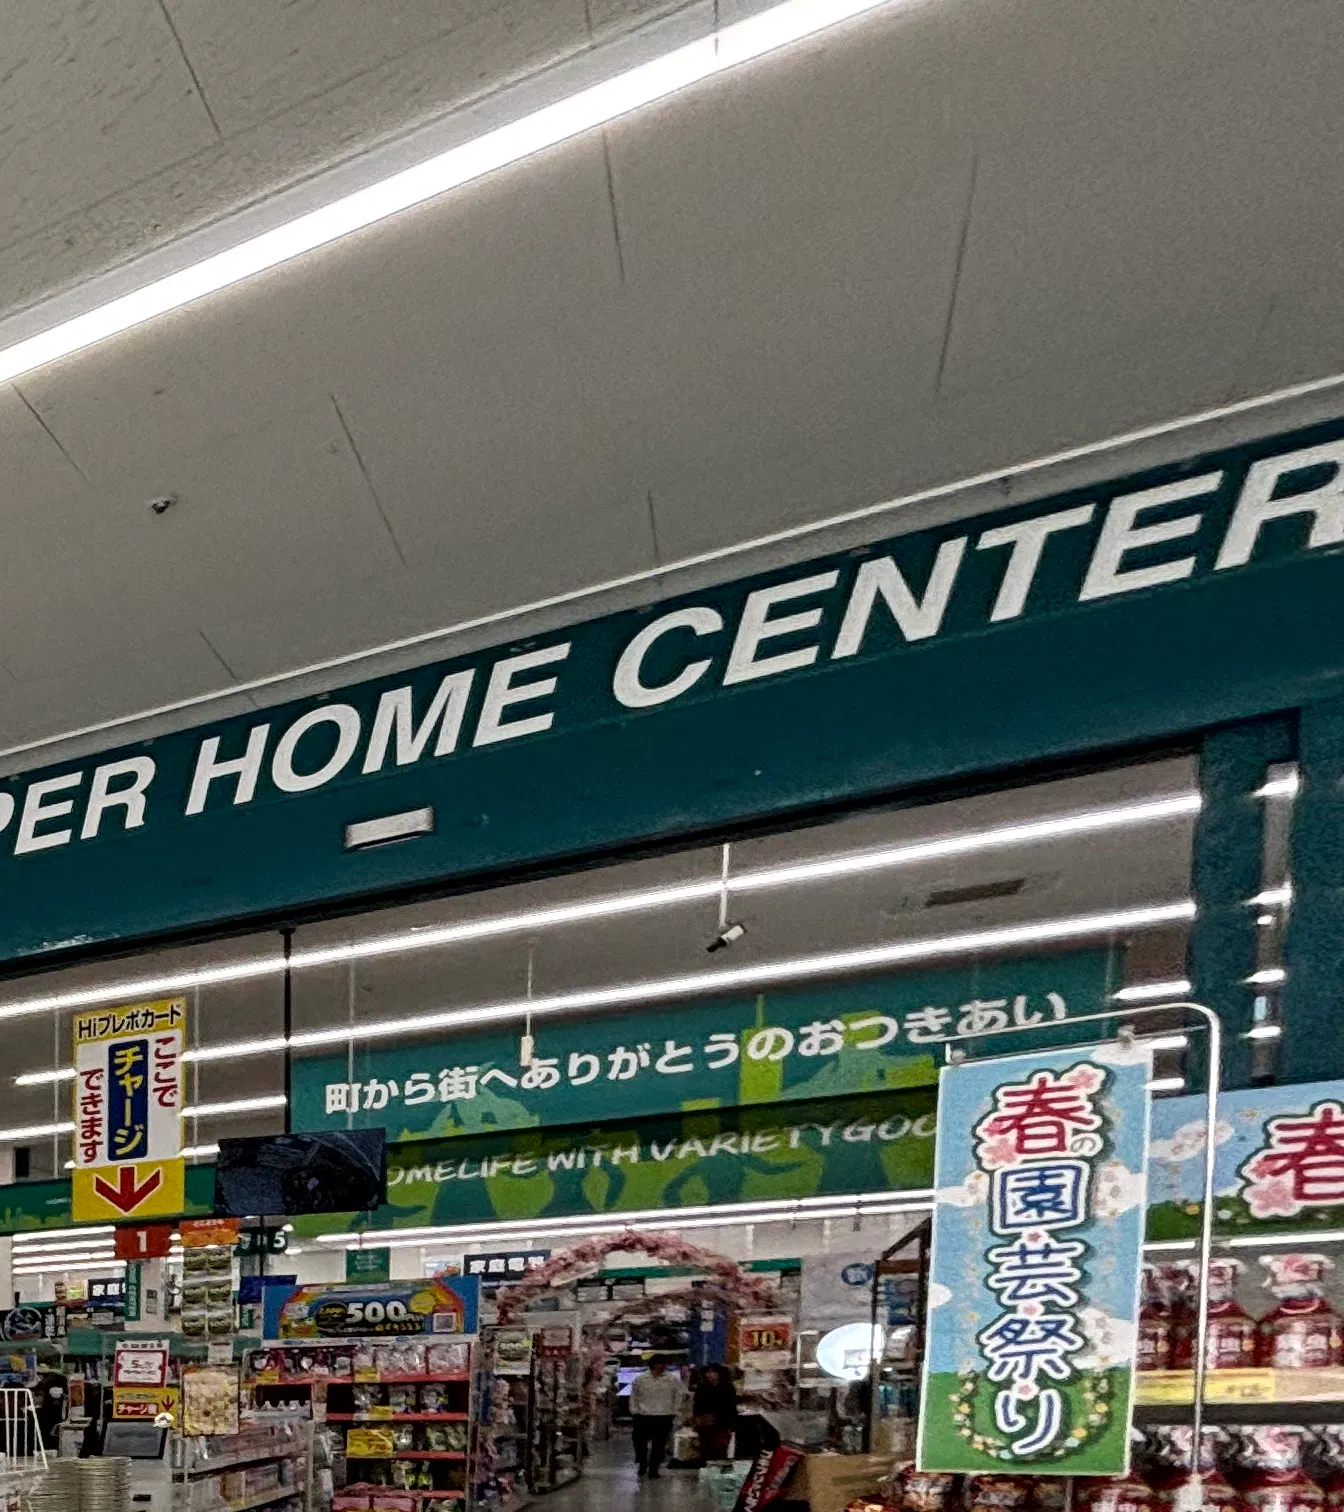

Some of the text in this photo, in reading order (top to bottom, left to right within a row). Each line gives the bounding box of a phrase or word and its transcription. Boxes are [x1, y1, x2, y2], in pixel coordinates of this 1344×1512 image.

[184, 642, 571, 816] HOME
[611, 446, 1344, 708] CENTER
[152, 1036, 178, 1108] ここで
[325, 991, 1067, 1115] 町から街へありがとうのおつきあい
[79, 1067, 105, 1164] できます
[114, 1045, 144, 1156] チャージ
[386, 1113, 936, 1187] OMELIFE WITH VARIETY GOO
[135, 1231, 148, 1253] 1
[272, 1230, 287, 1249] 5
[346, 1300, 407, 1323] 500
